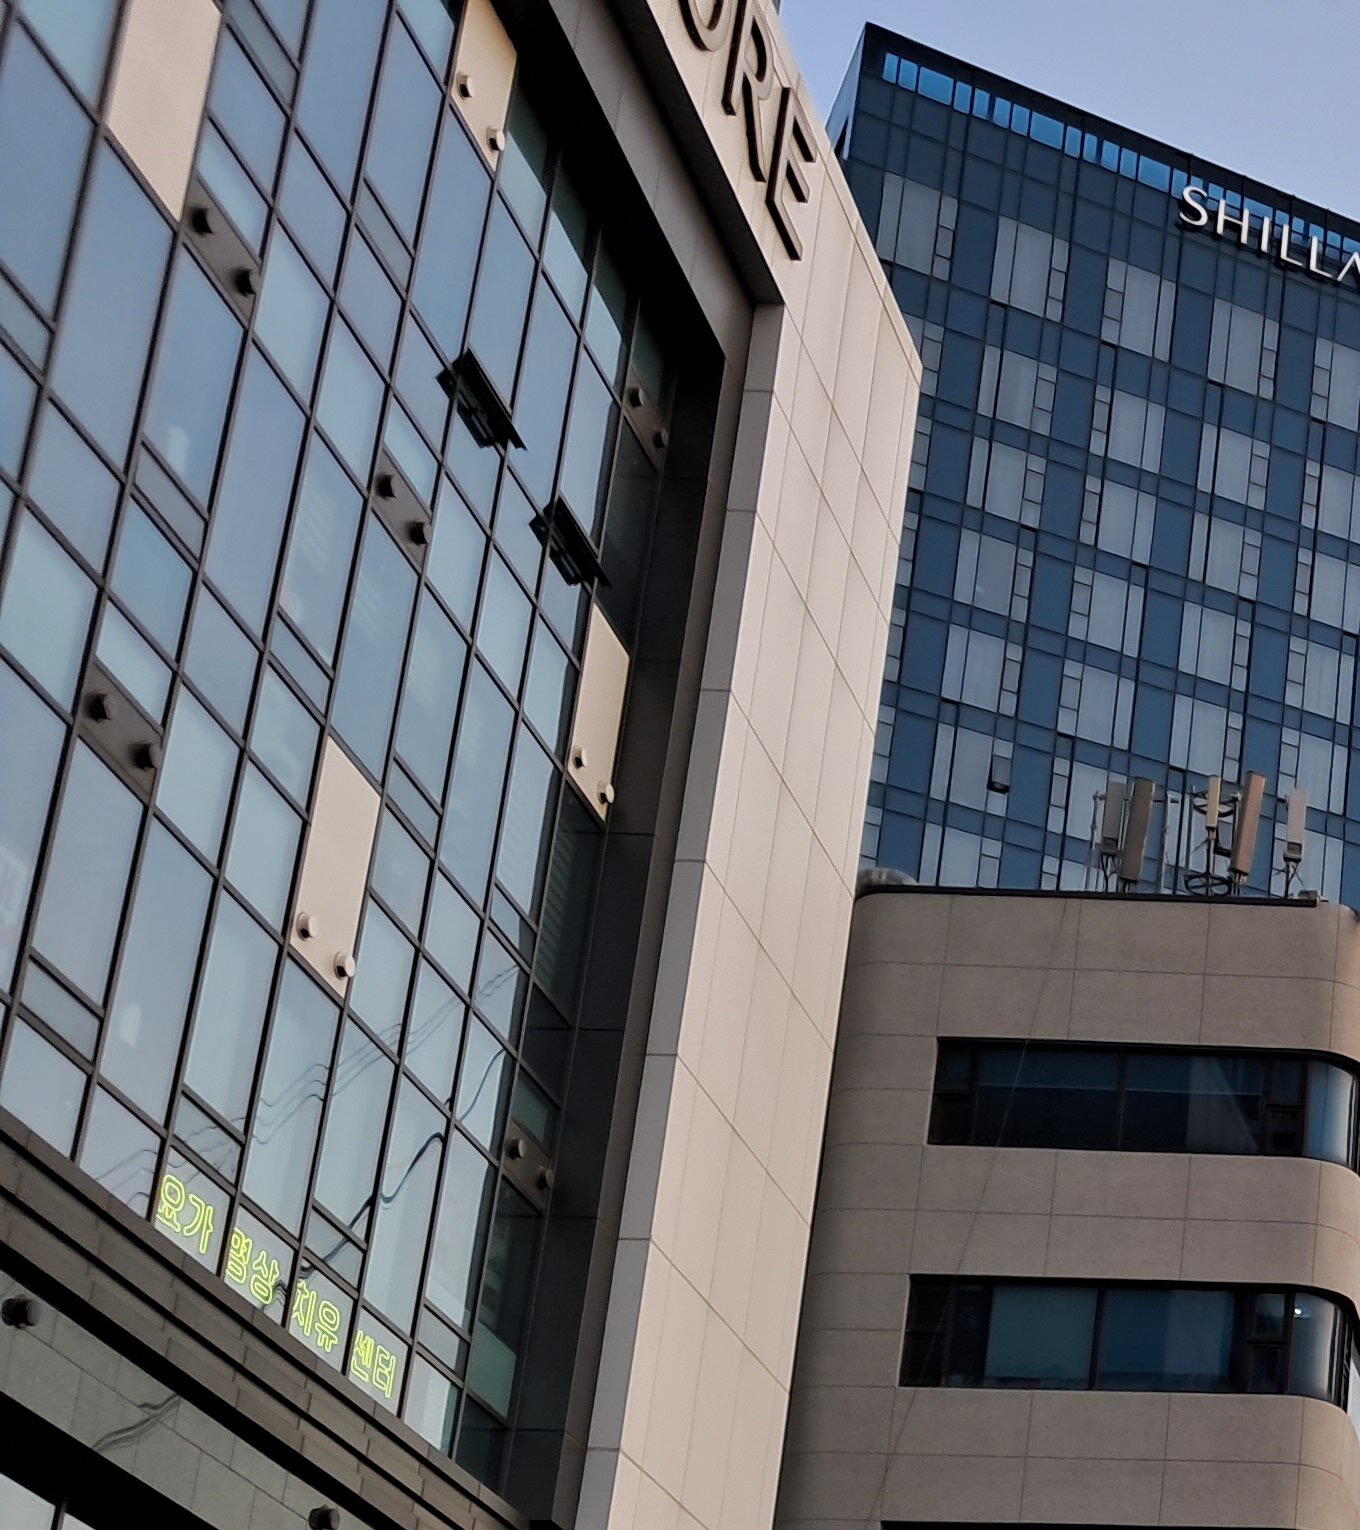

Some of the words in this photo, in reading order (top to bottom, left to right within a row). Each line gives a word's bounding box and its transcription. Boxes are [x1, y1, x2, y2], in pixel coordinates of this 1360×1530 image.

[156, 1173, 214, 1254] 요가
[225, 1226, 280, 1305] 명상
[291, 1279, 340, 1352] 치유
[351, 1330, 397, 1398] 센터
